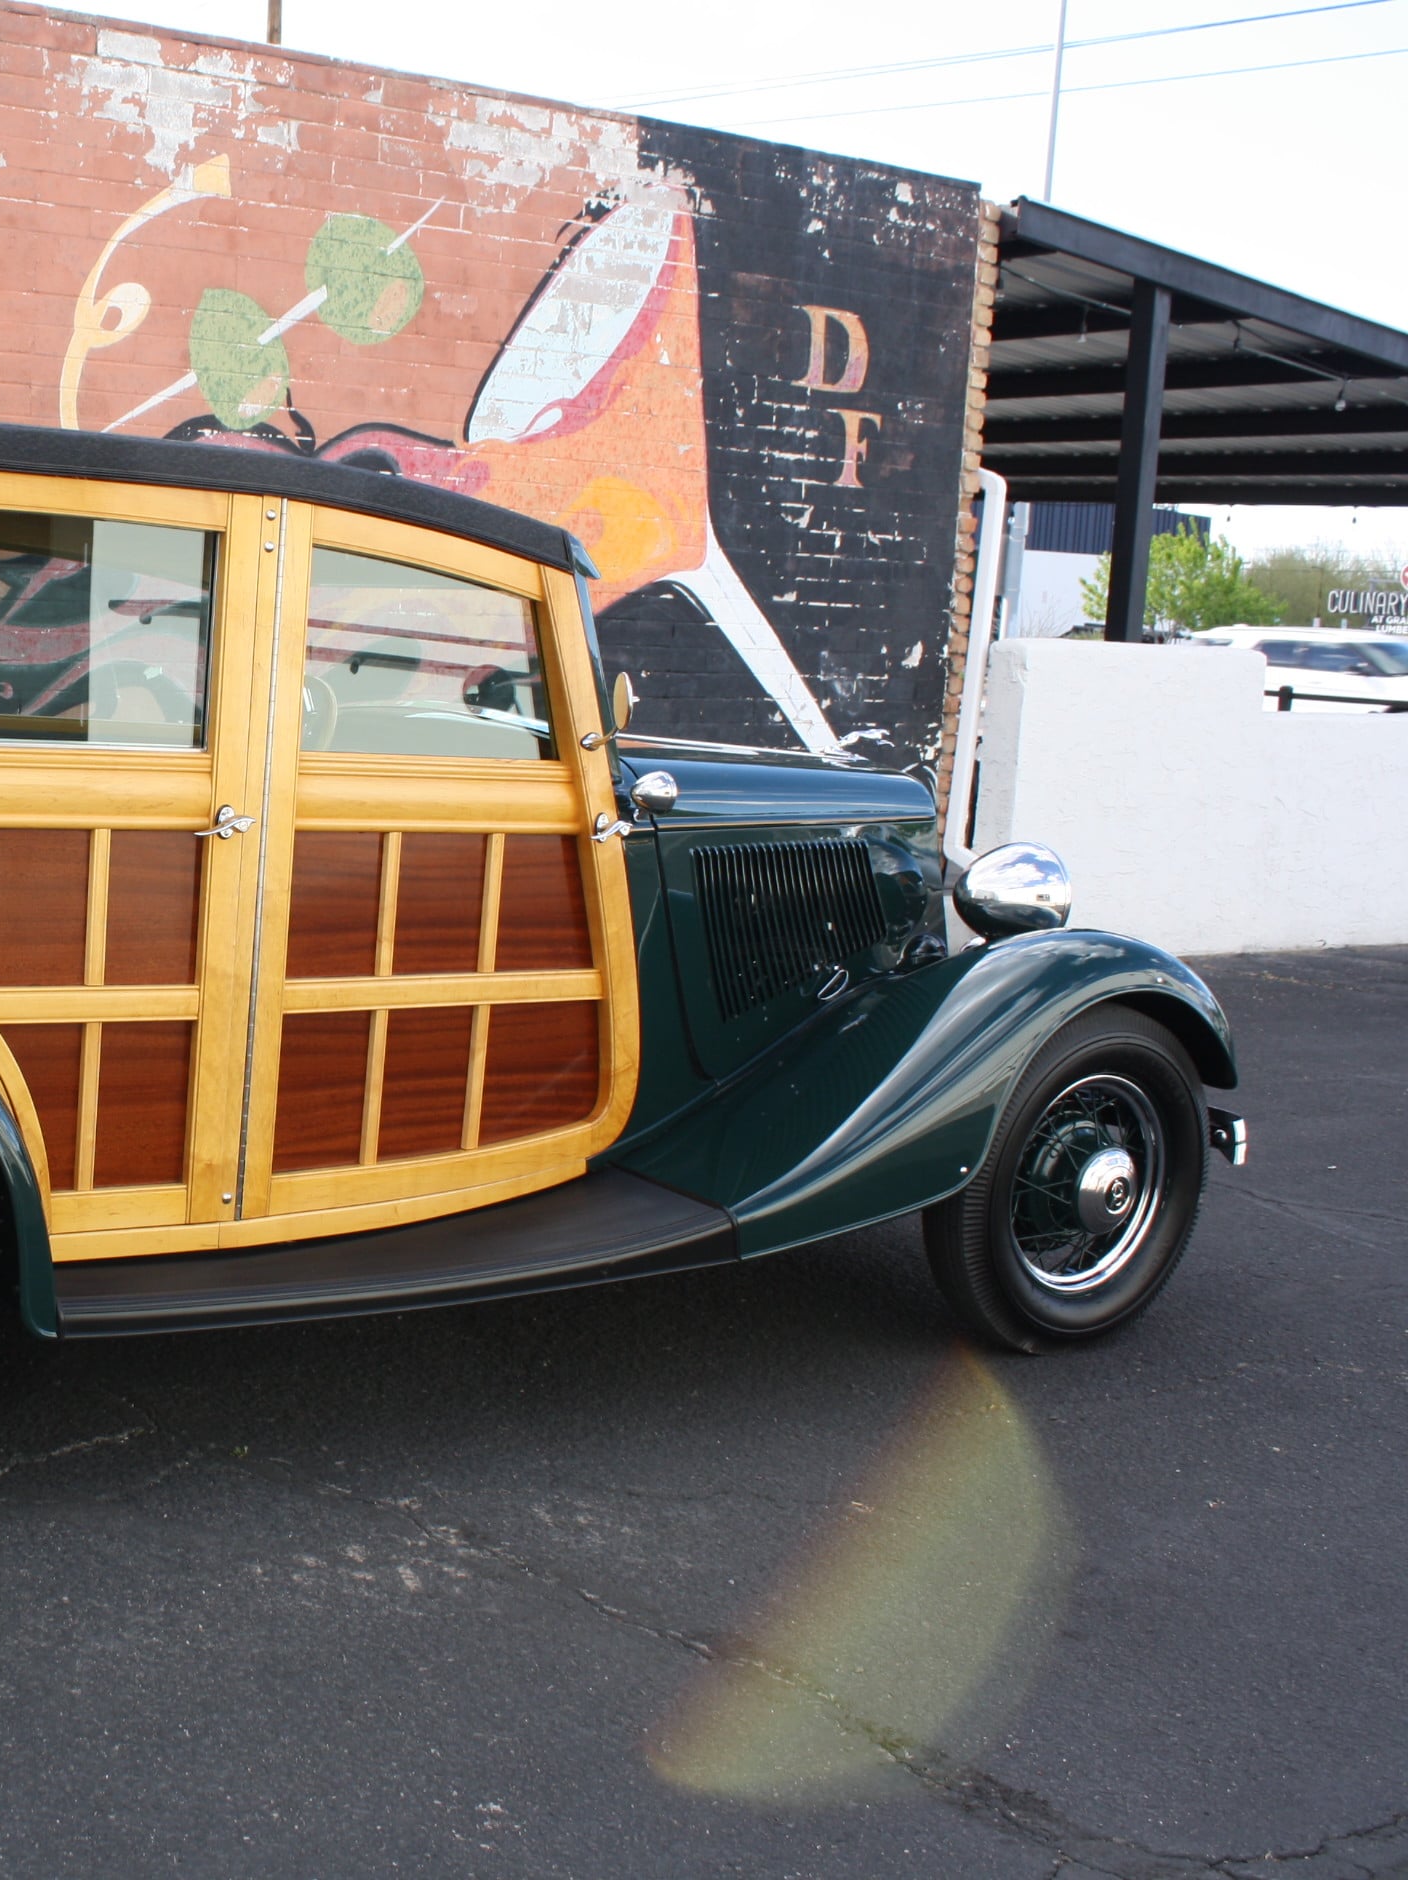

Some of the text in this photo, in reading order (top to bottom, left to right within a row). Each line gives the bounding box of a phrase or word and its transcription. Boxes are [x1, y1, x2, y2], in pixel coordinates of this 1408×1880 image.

[792, 305, 869, 393] D
[832, 410, 881, 488] F
[1328, 590, 1408, 616] CULINARY
[1371, 615, 1408, 625] AT GRA
